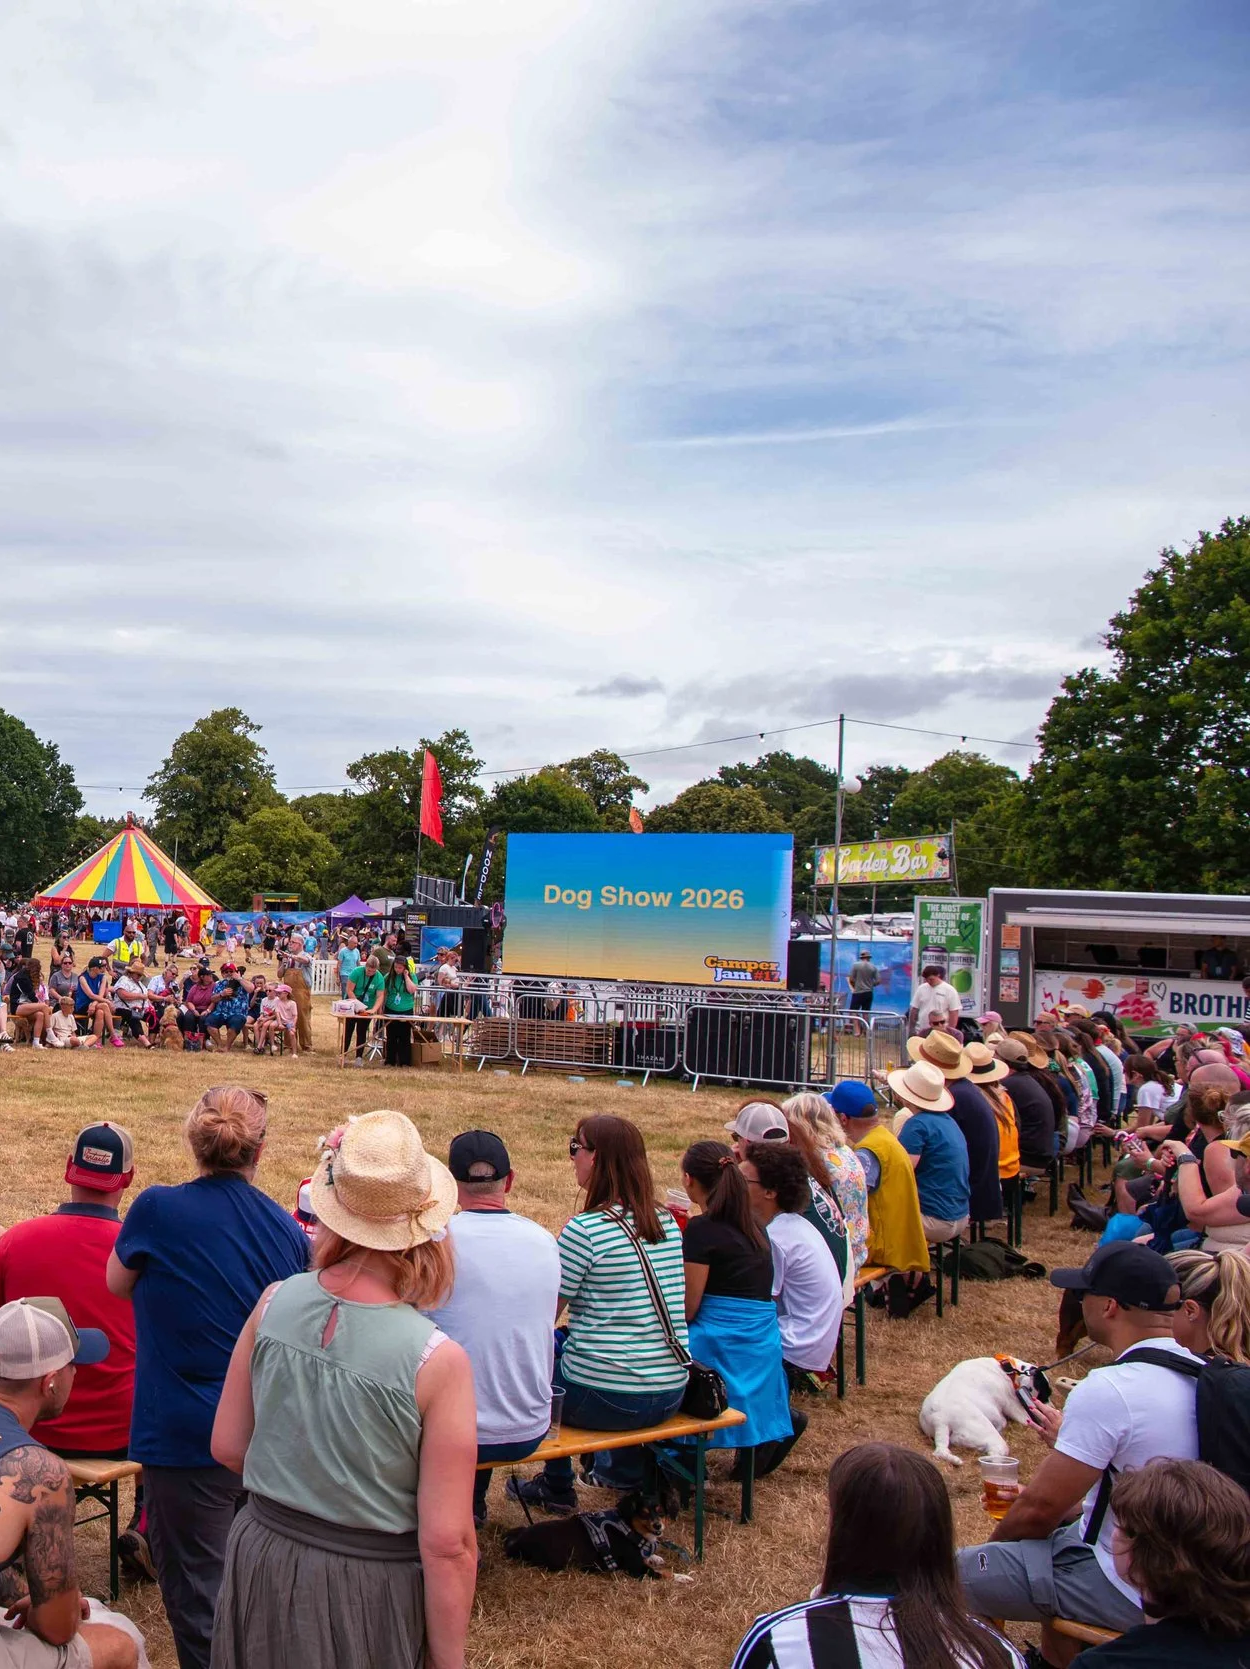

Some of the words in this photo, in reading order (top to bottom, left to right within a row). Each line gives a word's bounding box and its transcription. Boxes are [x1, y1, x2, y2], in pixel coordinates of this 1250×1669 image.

[838, 848, 889, 880] Garden
[890, 844, 929, 874] Bar
[477, 850, 493, 900] NOODLE
[544, 885, 592, 909] Dog
[600, 885, 673, 907] Show
[680, 888, 744, 909] 2026
[926, 903, 940, 911] THE
[941, 904, 960, 912] MOST
[931, 912, 960, 920] AMOUNT
[922, 920, 947, 928] SMILES
[948, 920, 956, 928] IN
[923, 927, 937, 936] ONE
[938, 928, 960, 936] PLACE
[928, 936, 946, 944] EVER
[705, 956, 779, 971] Camper
[714, 967, 752, 982] Jam
[754, 970, 780, 982] #17
